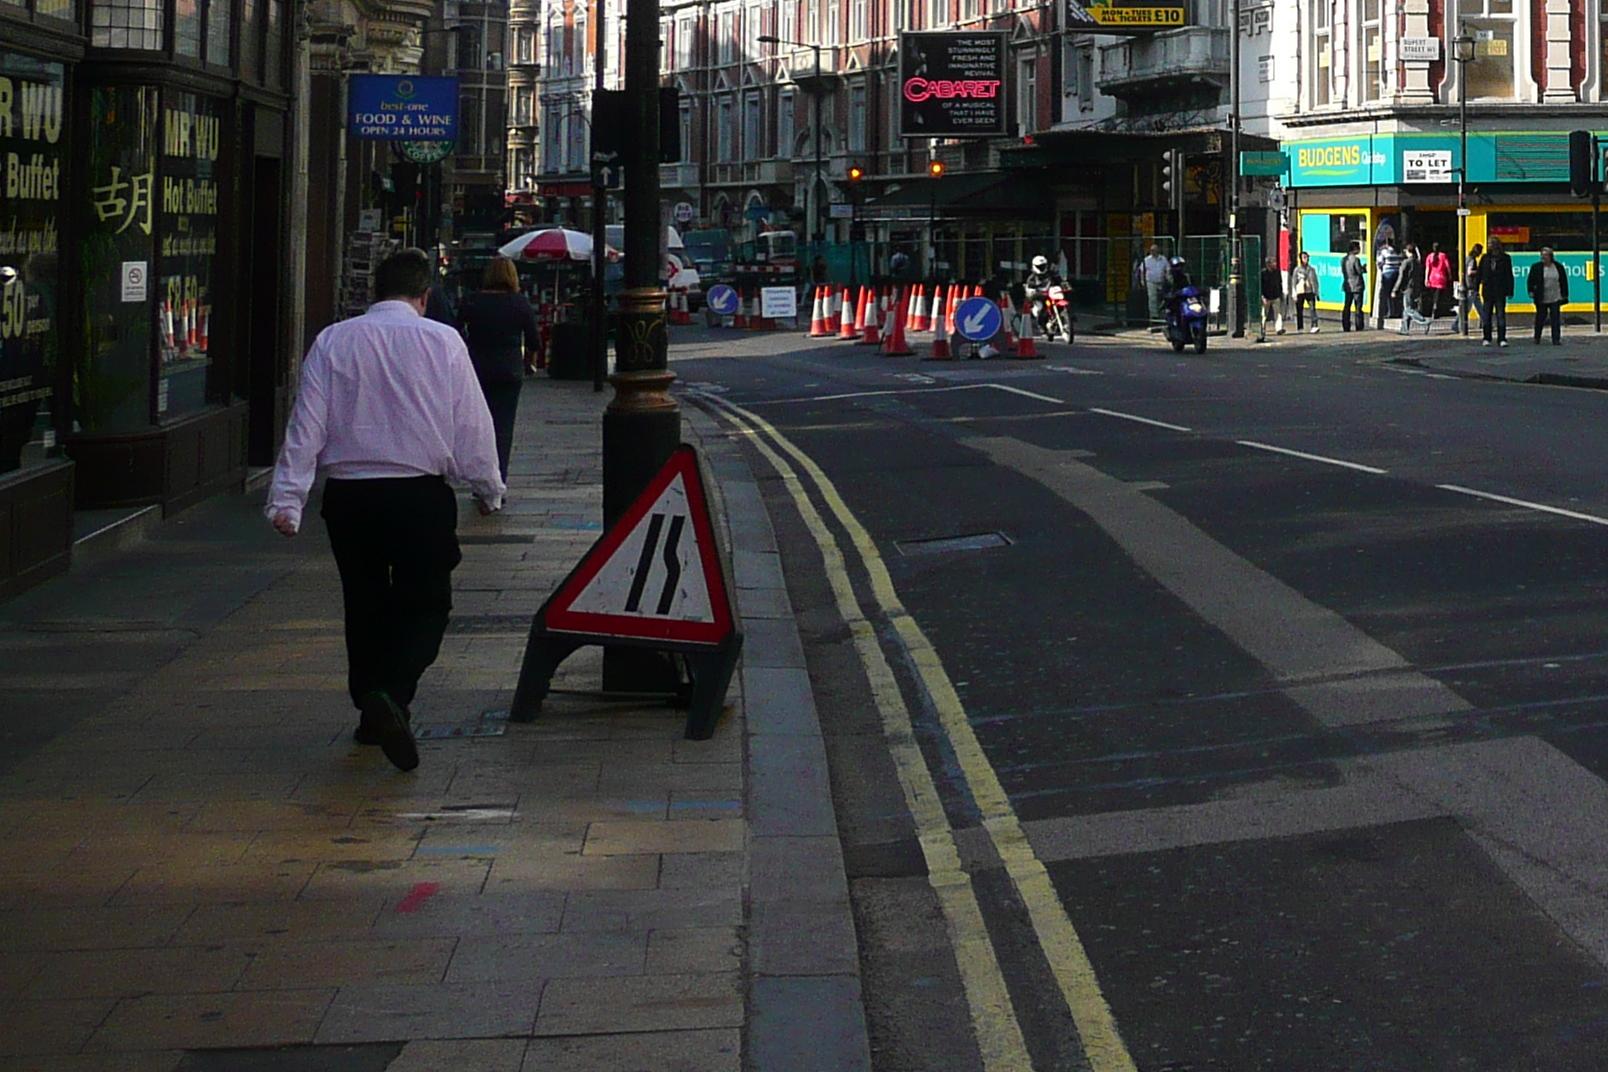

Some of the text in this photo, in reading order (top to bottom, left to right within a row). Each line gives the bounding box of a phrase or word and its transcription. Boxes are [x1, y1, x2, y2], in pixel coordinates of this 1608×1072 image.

[1154, 10, 1180, 22] £10
[21, 80, 63, 144] WU
[355, 113, 452, 126] FOOD & WINE
[164, 108, 220, 162] MR WU
[361, 126, 446, 136] OPEN 24 HOURS
[1298, 145, 1360, 167] BUDGENS
[1408, 159, 1447, 167] TO LET
[6, 152, 60, 201] Buffet
[92, 165, 154, 236] 胡
[163, 176, 218, 215] Hot Buffet
